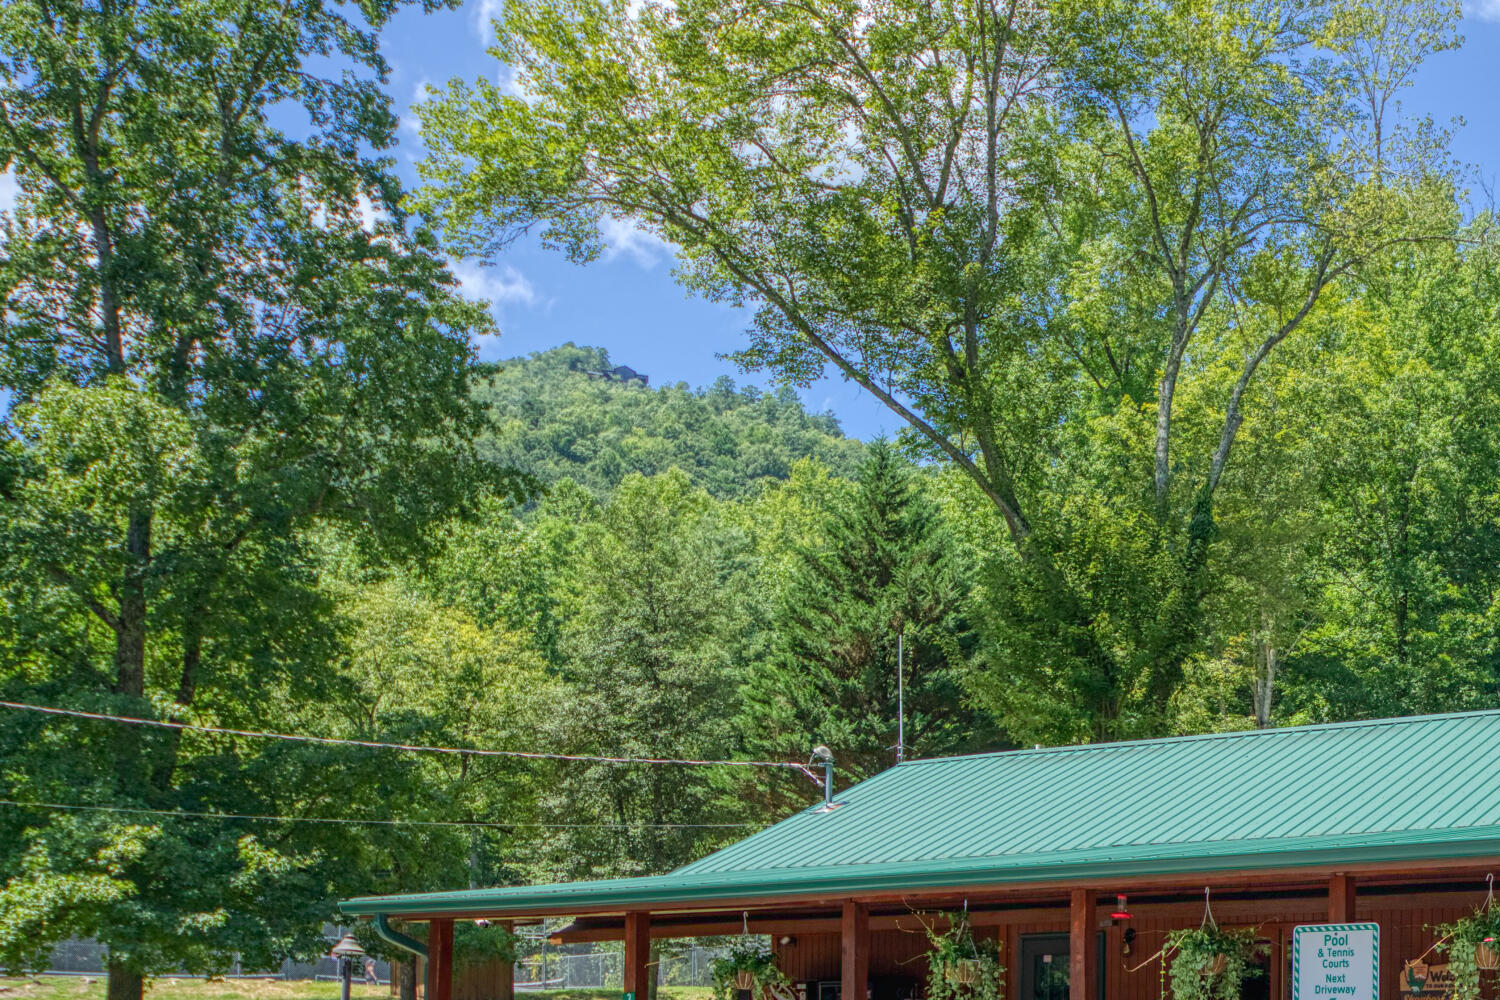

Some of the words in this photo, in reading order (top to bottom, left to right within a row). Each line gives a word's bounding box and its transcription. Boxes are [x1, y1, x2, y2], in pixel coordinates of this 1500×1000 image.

[1323, 933, 1349, 947] Pool
[1317, 948, 1324, 958] &
[1327, 947, 1355, 957] Tennis
[1322, 959, 1350, 969] Courts
[1325, 973, 1346, 983] Next
[1314, 985, 1356, 996] Driveway
